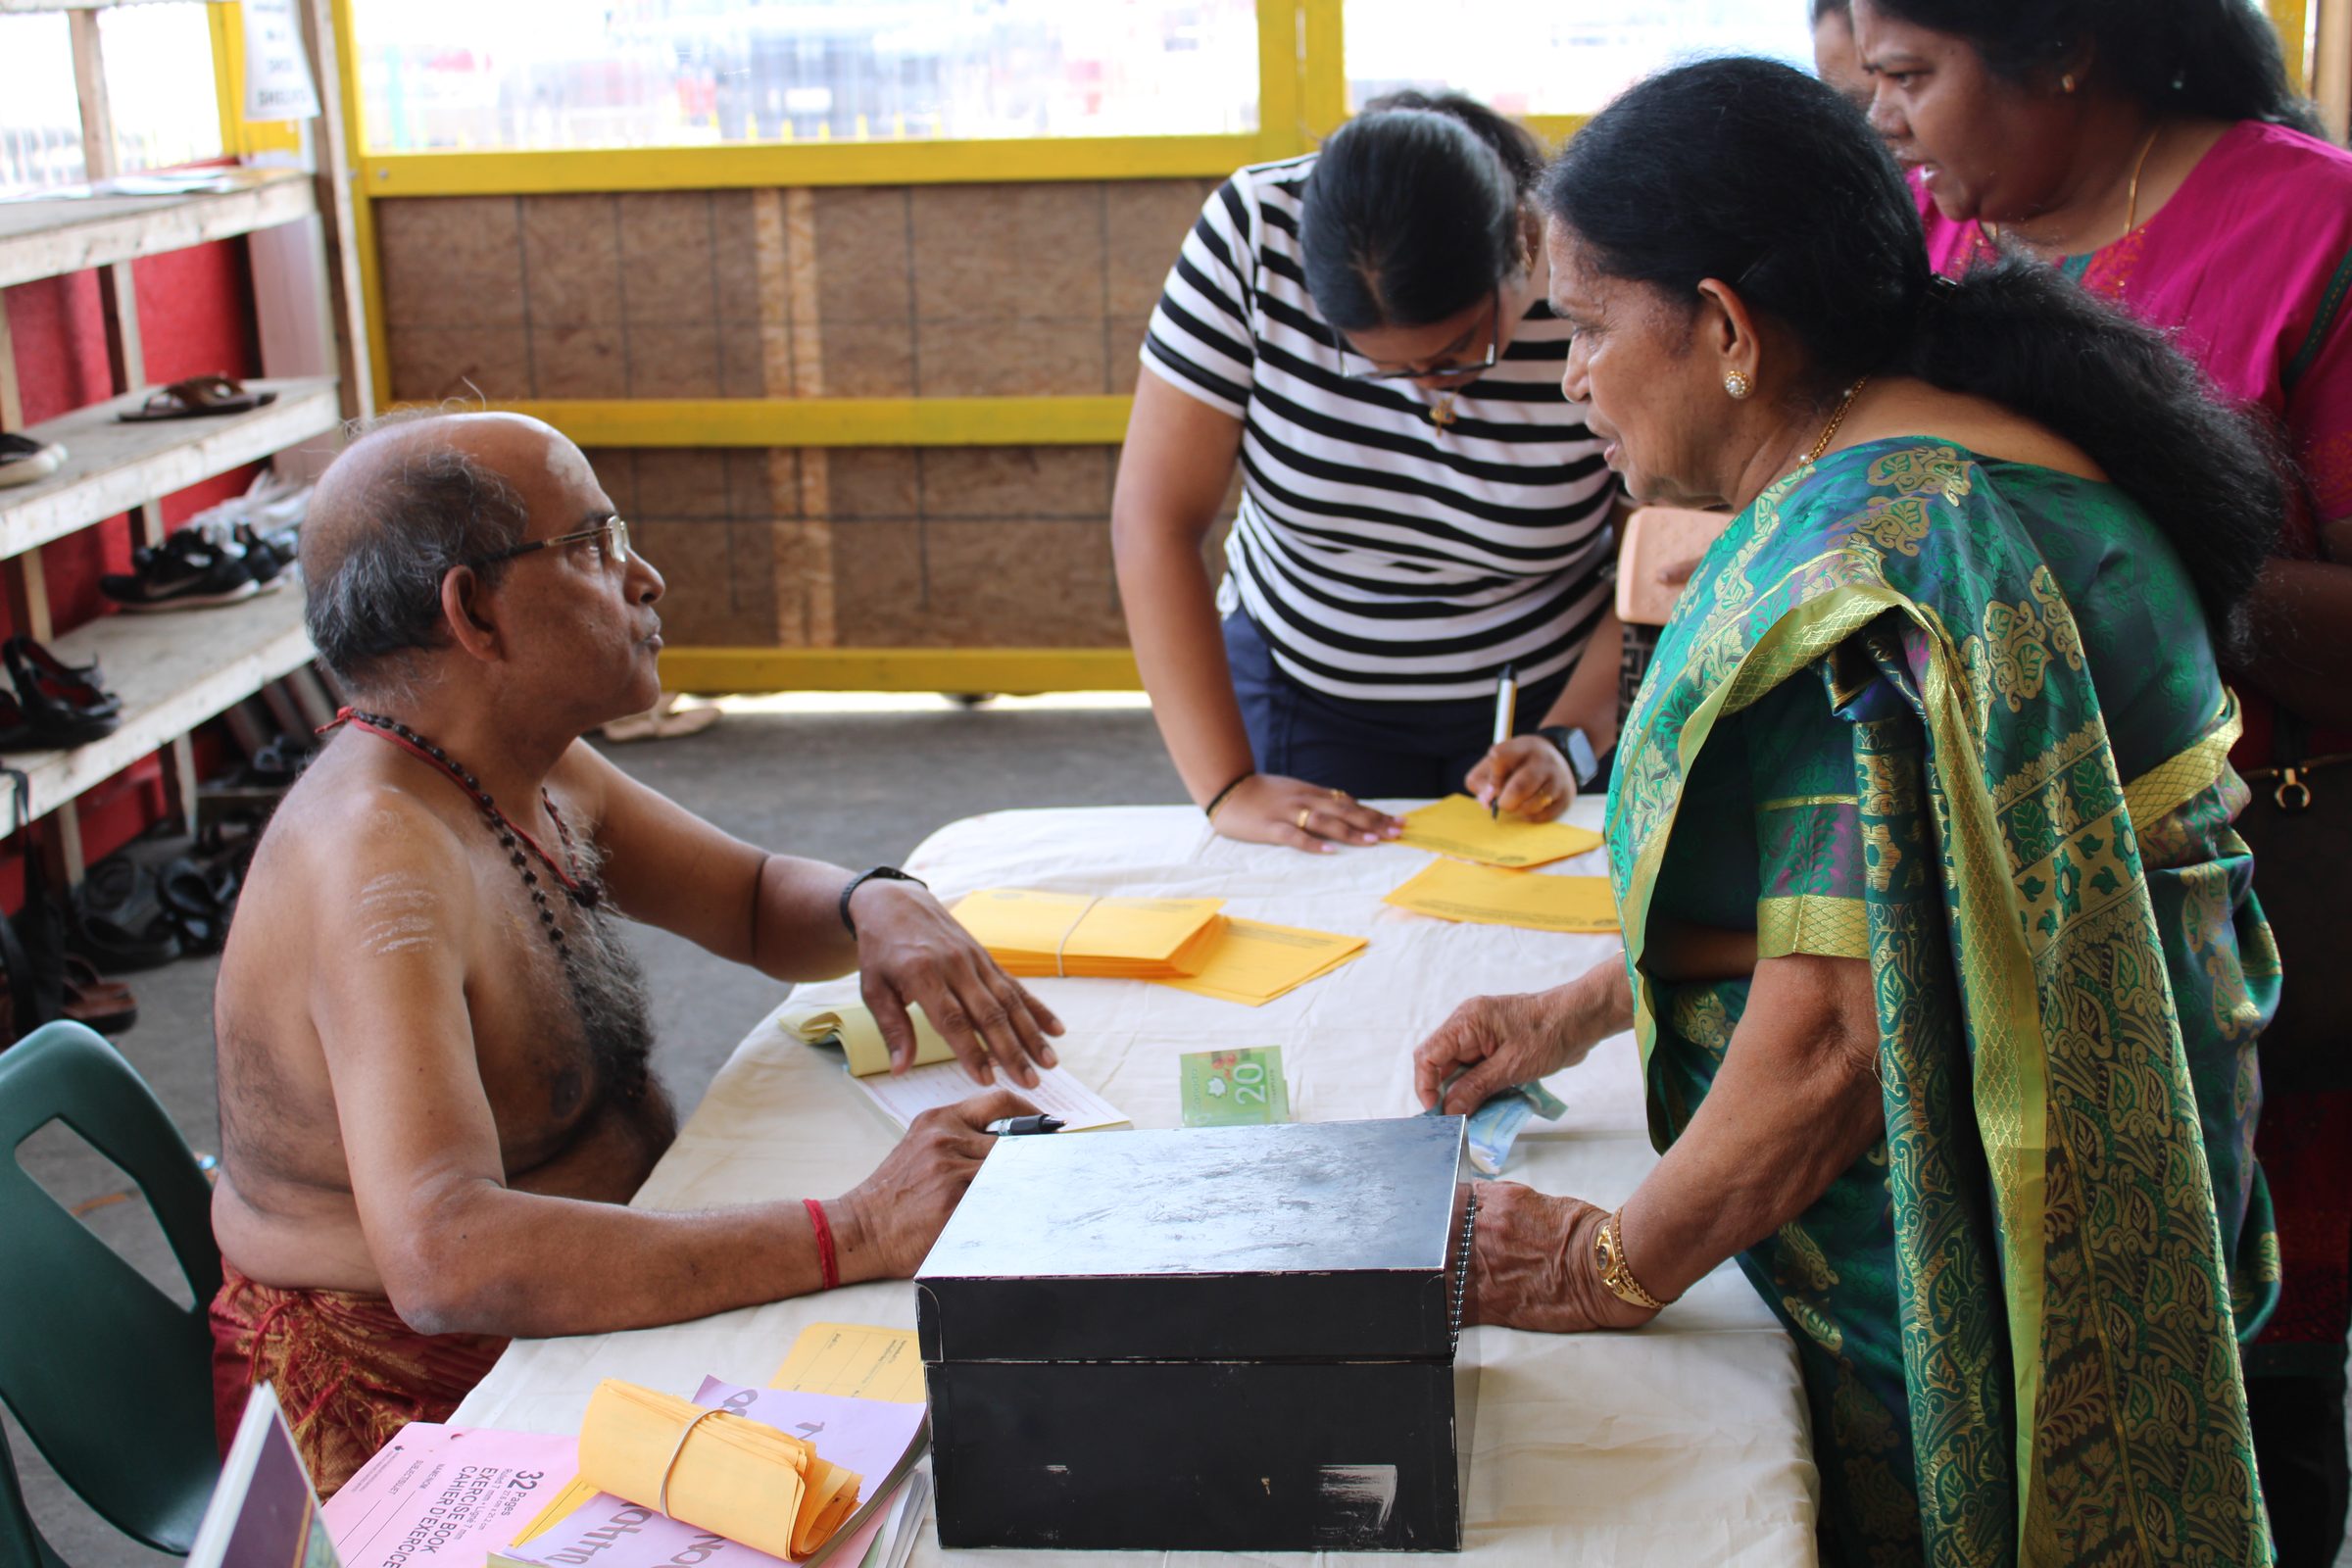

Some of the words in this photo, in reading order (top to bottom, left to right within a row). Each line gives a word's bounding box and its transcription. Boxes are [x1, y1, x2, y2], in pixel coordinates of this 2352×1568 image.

[1234, 1063, 1266, 1104] 20
[436, 1466, 477, 1505] CAHIER
[447, 1467, 499, 1521] EXERCISE
[508, 1470, 545, 1490] 32
[466, 1505, 485, 1524] Ligné
[501, 1491, 526, 1516] Pages
[420, 1522, 458, 1553] BOOK
